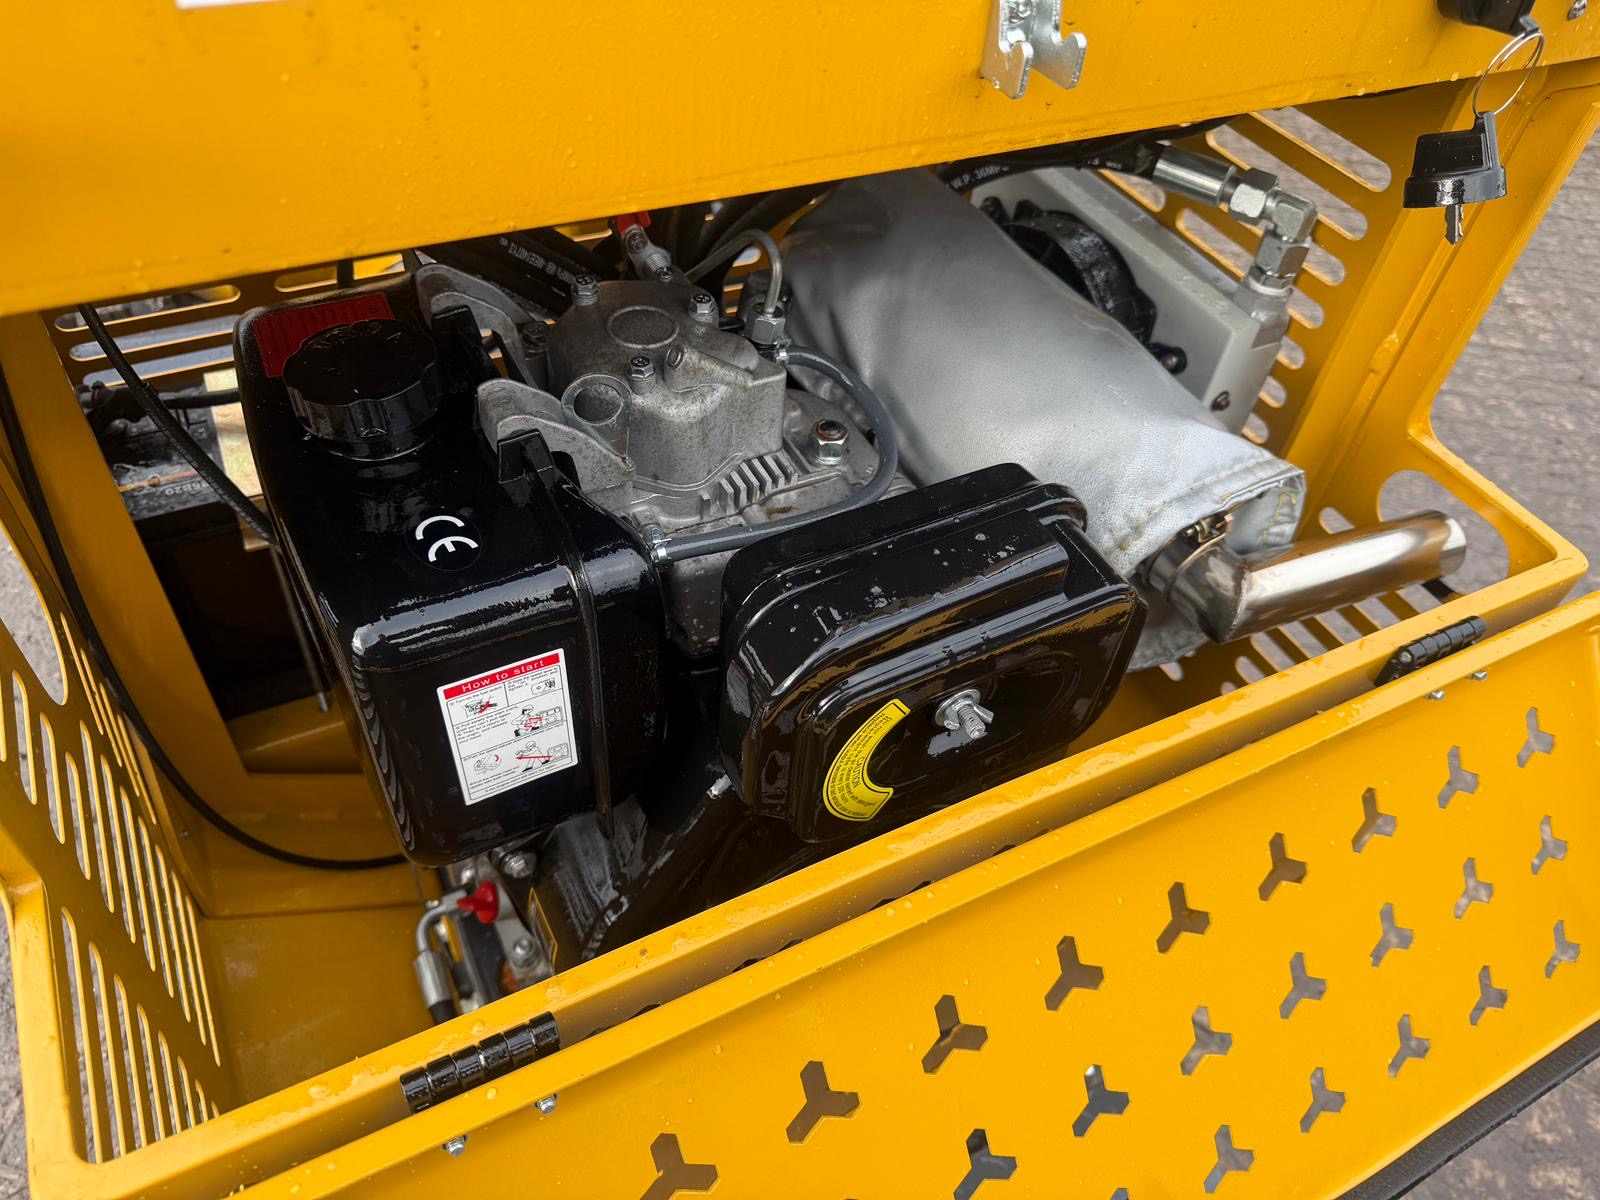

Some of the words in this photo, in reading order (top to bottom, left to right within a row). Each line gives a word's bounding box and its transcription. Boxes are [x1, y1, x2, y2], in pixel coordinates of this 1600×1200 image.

[415, 515, 479, 562] CE
[462, 678, 490, 693] How
[496, 672, 508, 681] to
[514, 660, 544, 674] start
